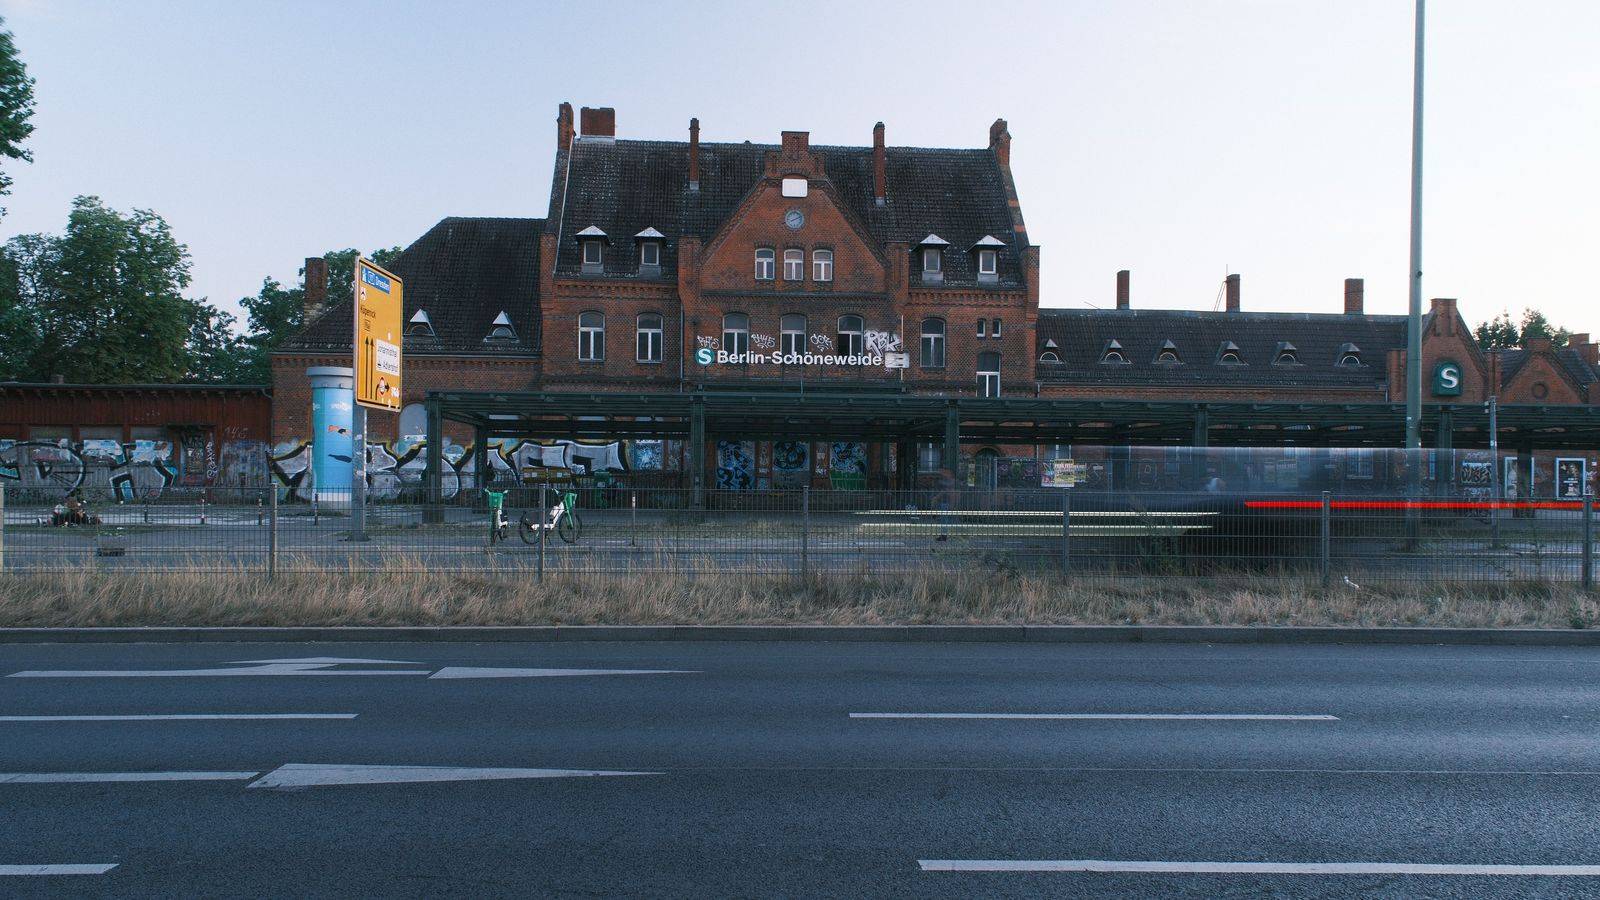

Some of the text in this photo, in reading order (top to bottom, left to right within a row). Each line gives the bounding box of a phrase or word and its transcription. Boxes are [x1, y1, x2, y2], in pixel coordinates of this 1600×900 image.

[698, 348, 882, 366] S Berlin-Schöneweide
[1440, 367, 1458, 389] S
